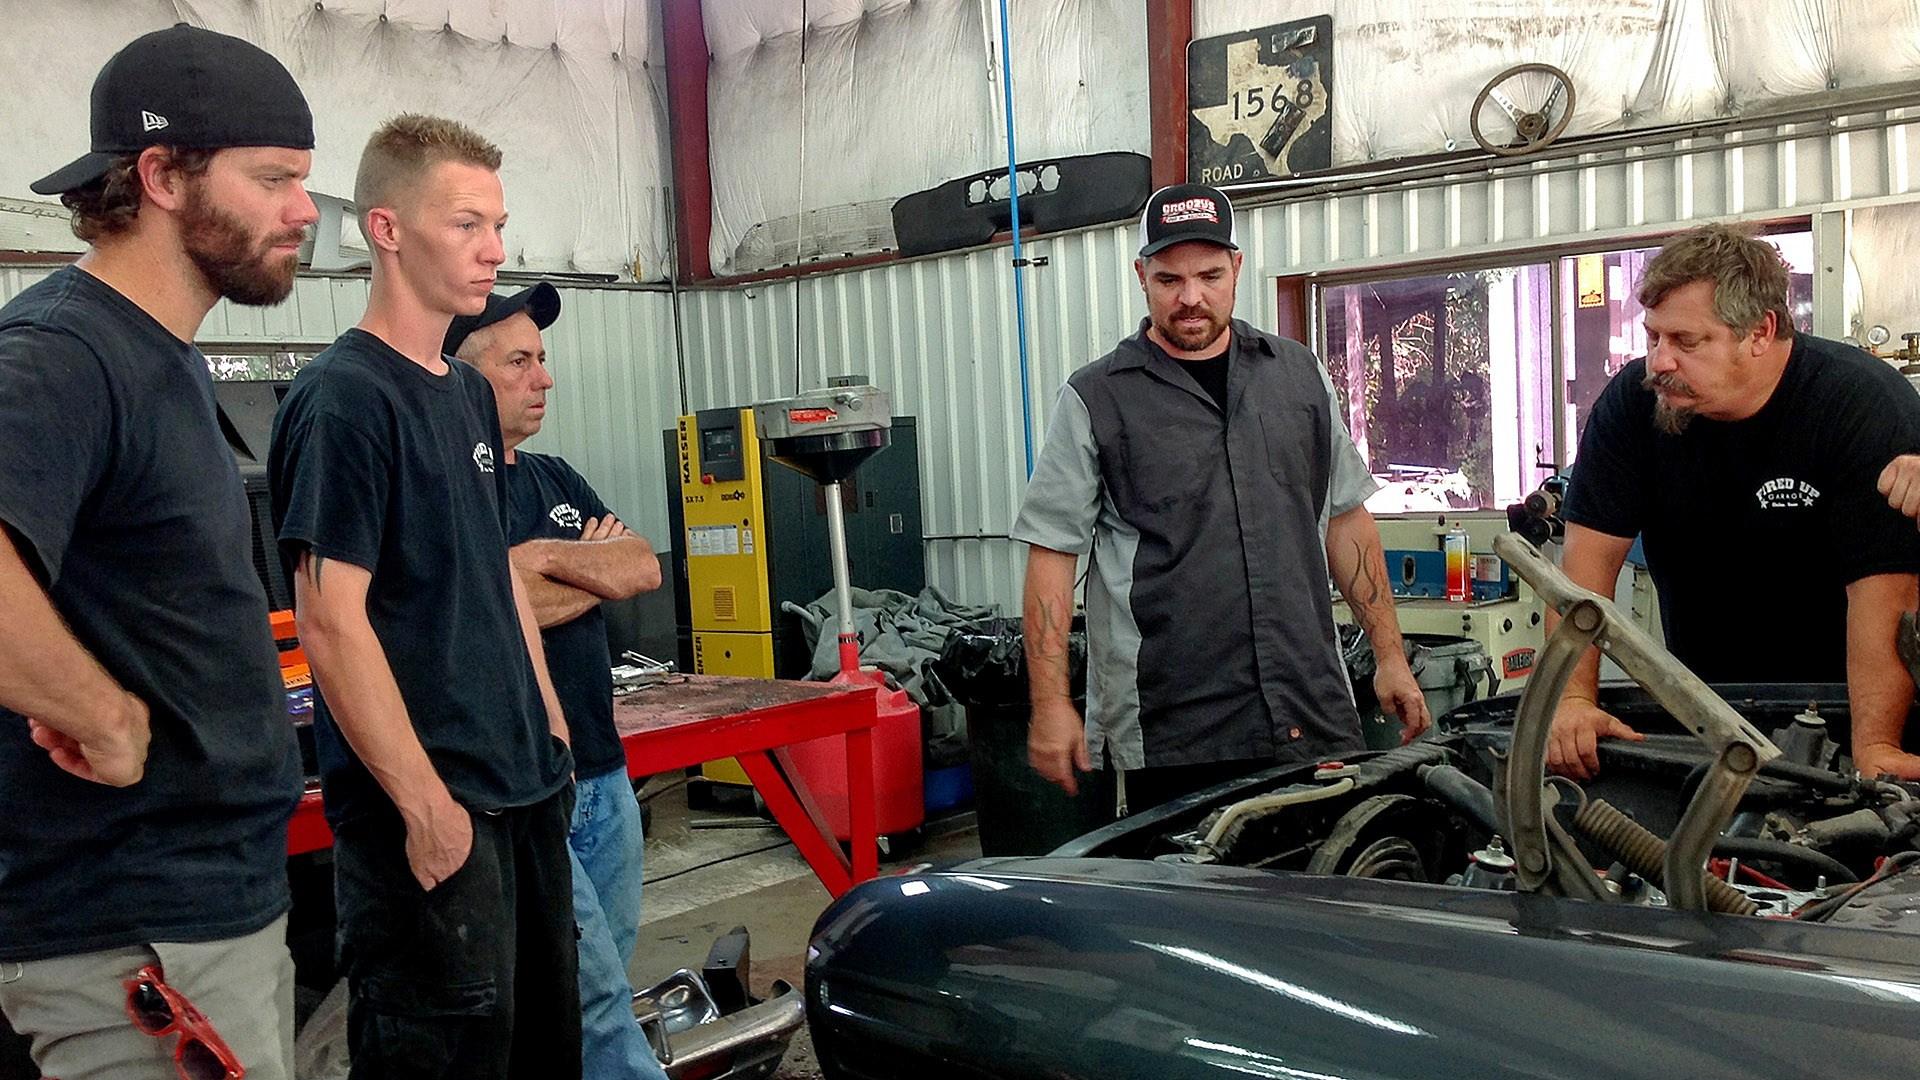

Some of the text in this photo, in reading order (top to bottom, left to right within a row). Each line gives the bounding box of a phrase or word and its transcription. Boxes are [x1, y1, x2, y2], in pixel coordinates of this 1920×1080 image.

[1232, 79, 1314, 121] 1568
[1201, 163, 1244, 184] ROAD
[680, 421, 690, 484] KAESER
[1756, 478, 1820, 501] FIRED UP
[1767, 492, 1803, 501] GARAGE
